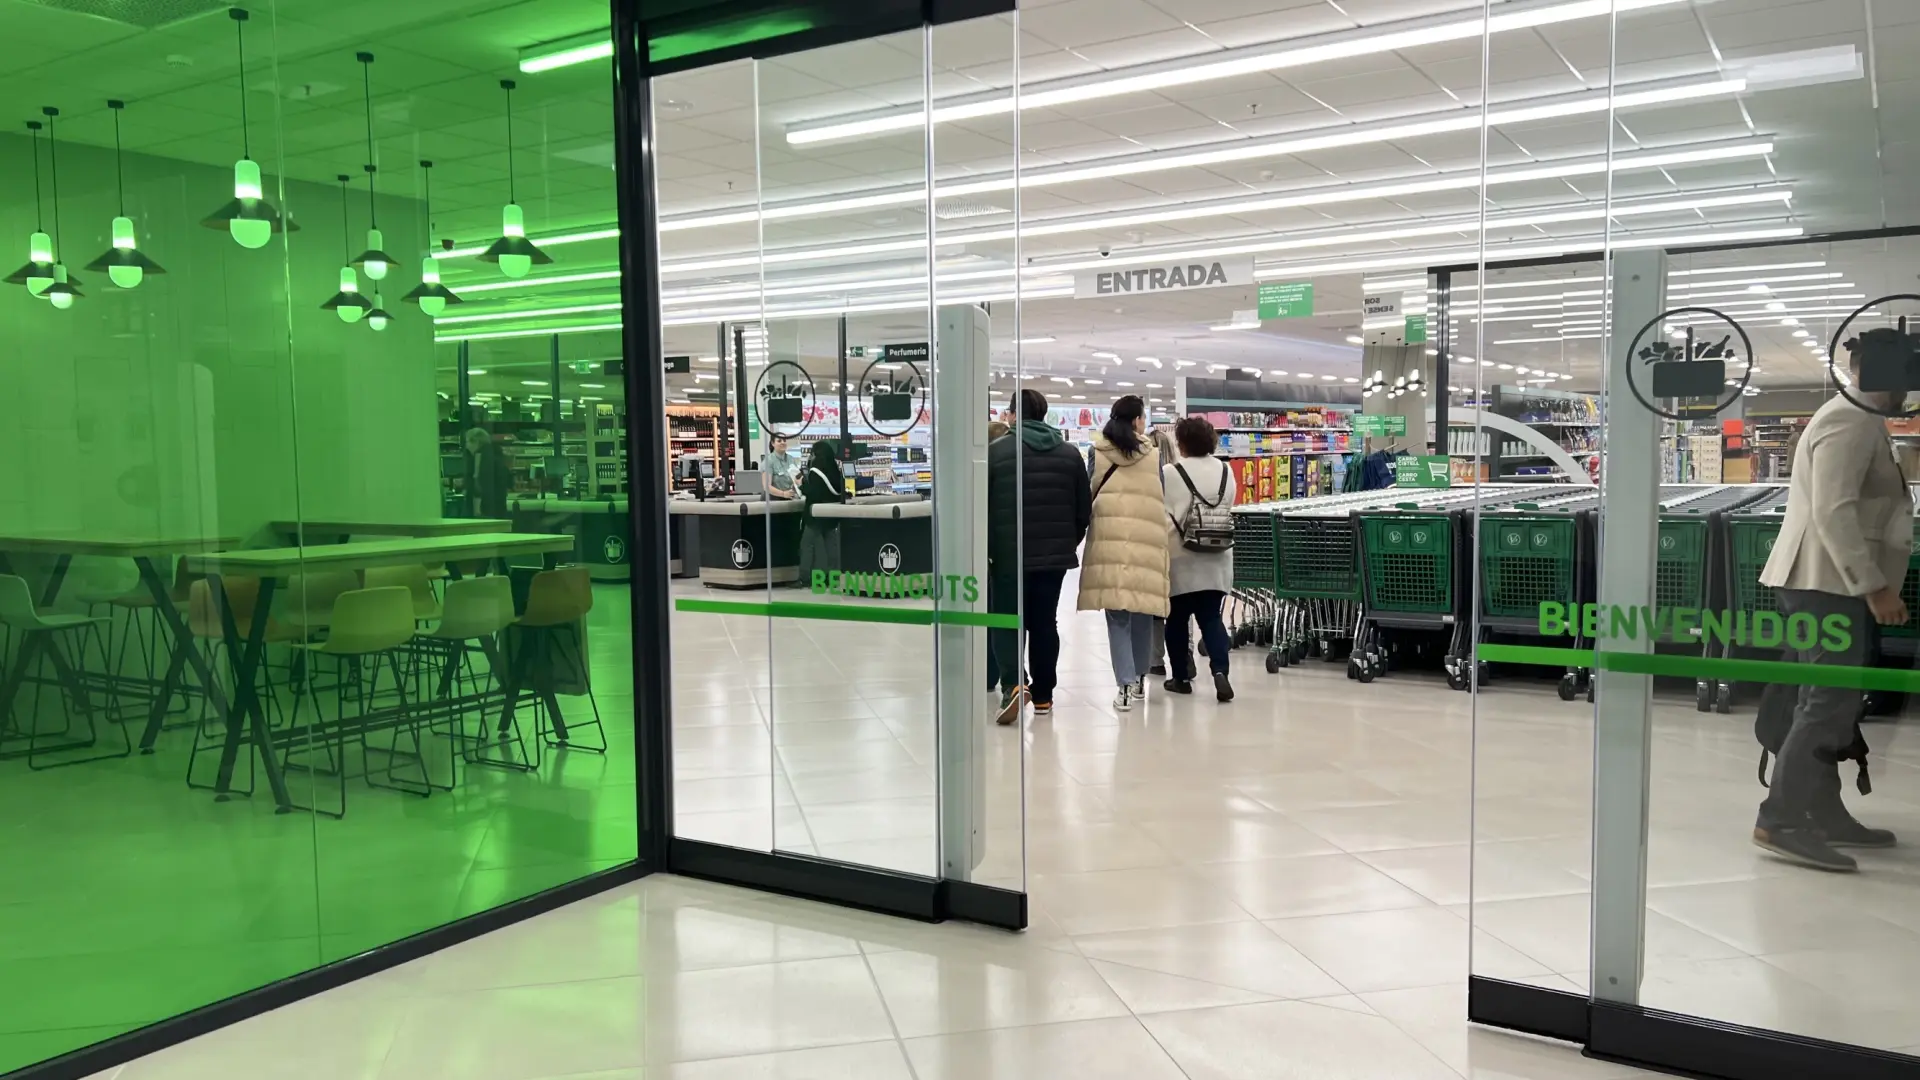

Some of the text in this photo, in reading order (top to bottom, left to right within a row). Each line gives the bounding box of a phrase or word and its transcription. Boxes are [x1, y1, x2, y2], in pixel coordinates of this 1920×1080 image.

[1097, 262, 1227, 294] ENTRADA
[889, 348, 926, 356] Perfumeria
[811, 569, 979, 603] BENVINGUTS
[1538, 600, 1852, 652] BIENVENIDOS
